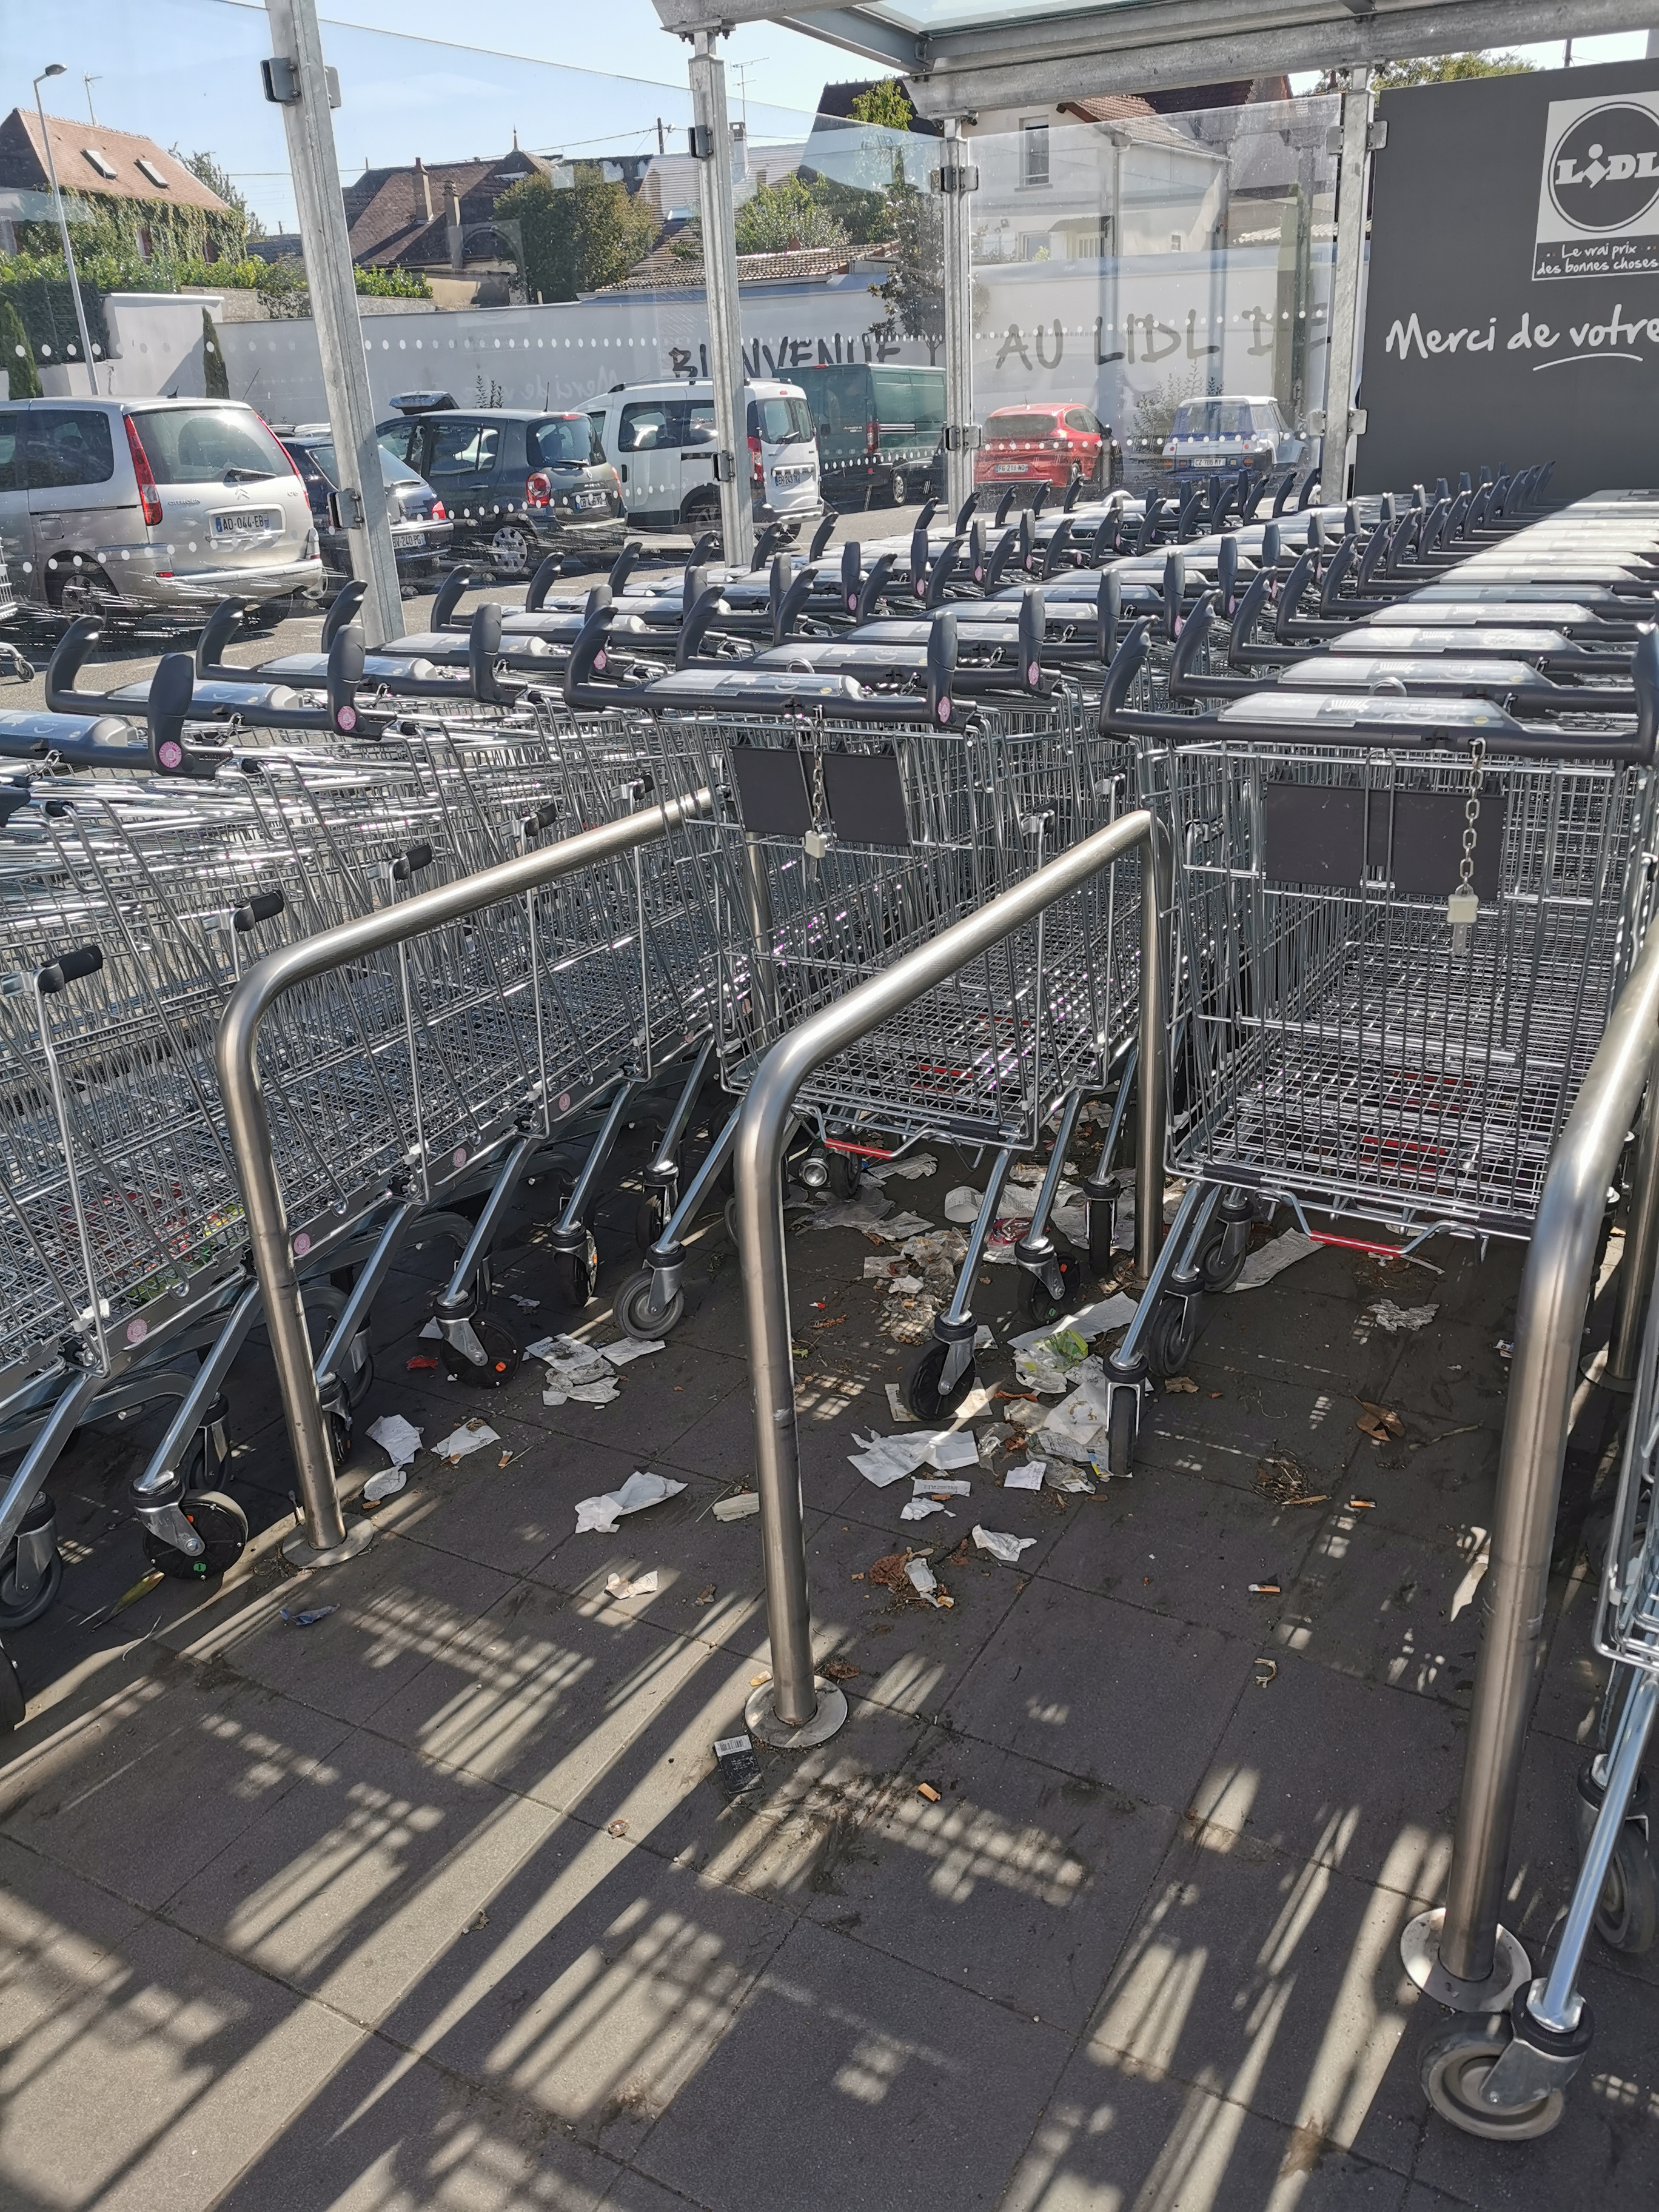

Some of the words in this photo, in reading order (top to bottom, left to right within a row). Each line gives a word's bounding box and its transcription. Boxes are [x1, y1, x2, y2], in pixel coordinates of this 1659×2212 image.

[1536, 261, 1561, 275] des
[1565, 258, 1610, 273] bonnes
[1613, 256, 1659, 270] choses
[1561, 244, 1582, 258] Le
[1584, 243, 1609, 256] vrai
[1612, 241, 1637, 260] prix
[996, 318, 1063, 370] AU
[1094, 309, 1220, 365] LIDL
[1386, 312, 1497, 360] Merci
[1507, 312, 1560, 349] de
[1569, 303, 1659, 347] votre
[668, 332, 901, 385] BINVENUE
[223, 515, 264, 531] AD-044-EB
